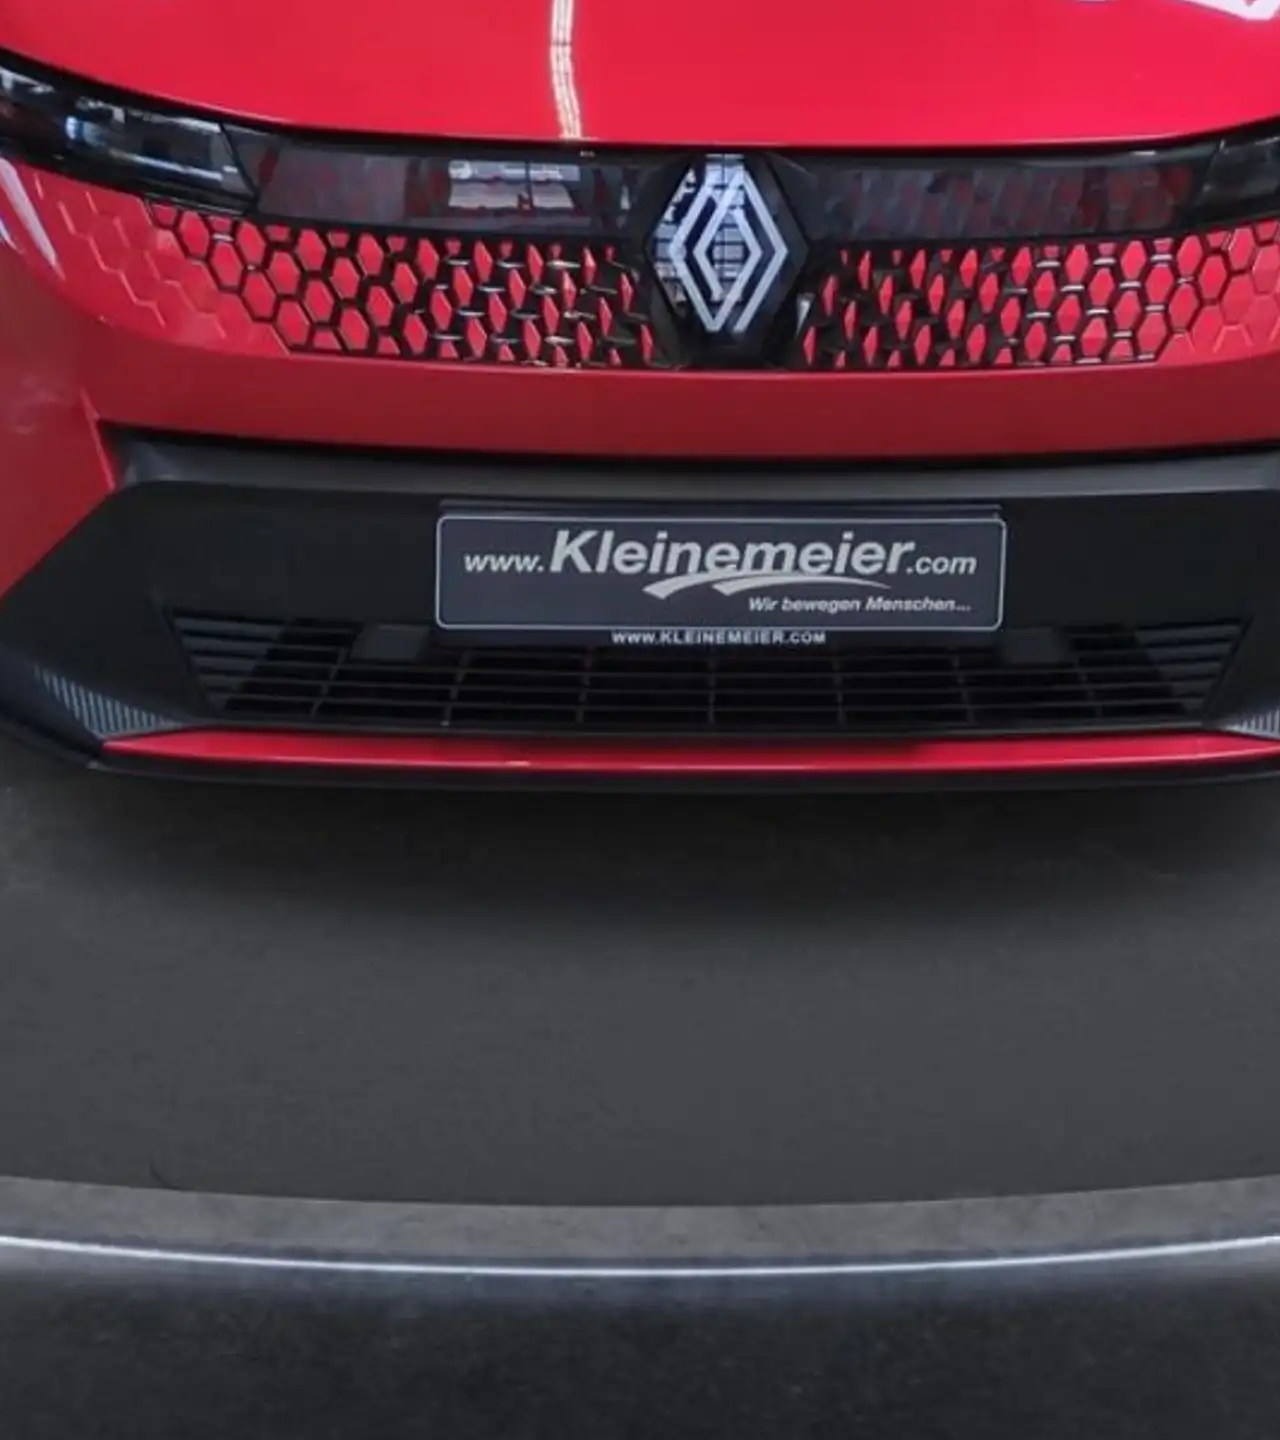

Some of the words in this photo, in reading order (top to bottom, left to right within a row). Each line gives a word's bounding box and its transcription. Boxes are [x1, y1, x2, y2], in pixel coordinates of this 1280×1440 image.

[464, 530, 977, 575] www.Kleinemeier.com
[749, 596, 778, 611] Wir
[781, 597, 861, 614] bewegen
[865, 596, 971, 612] Menschen...
